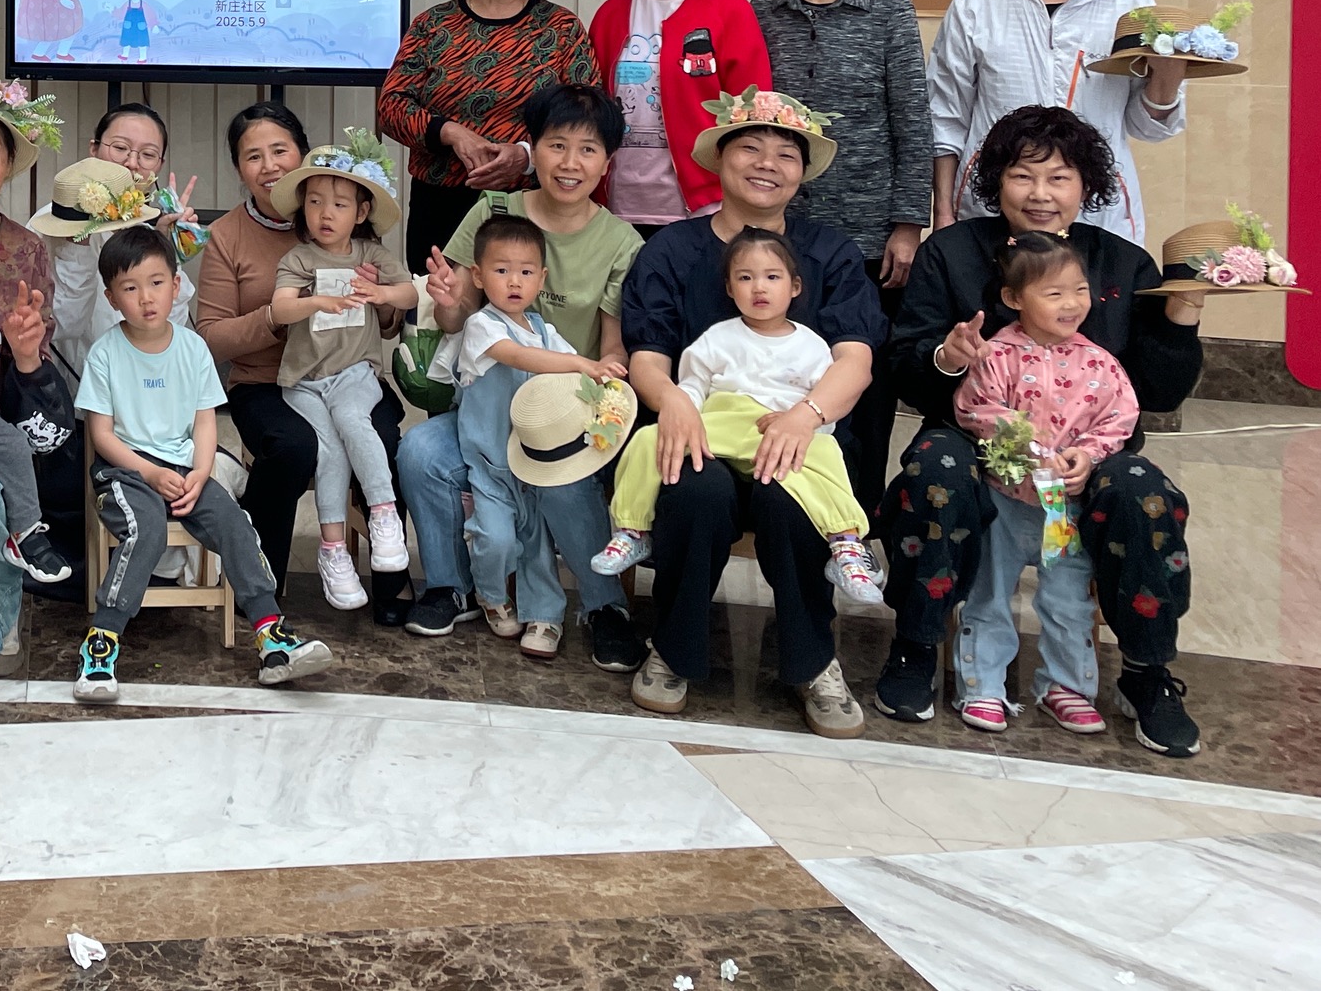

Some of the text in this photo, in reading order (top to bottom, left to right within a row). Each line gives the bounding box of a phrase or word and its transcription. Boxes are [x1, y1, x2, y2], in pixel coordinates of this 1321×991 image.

[215, 0, 267, 13] 新庄社区
[215, 16, 266, 28] 2025.5.9
[142, 378, 166, 389] TRAVEL
